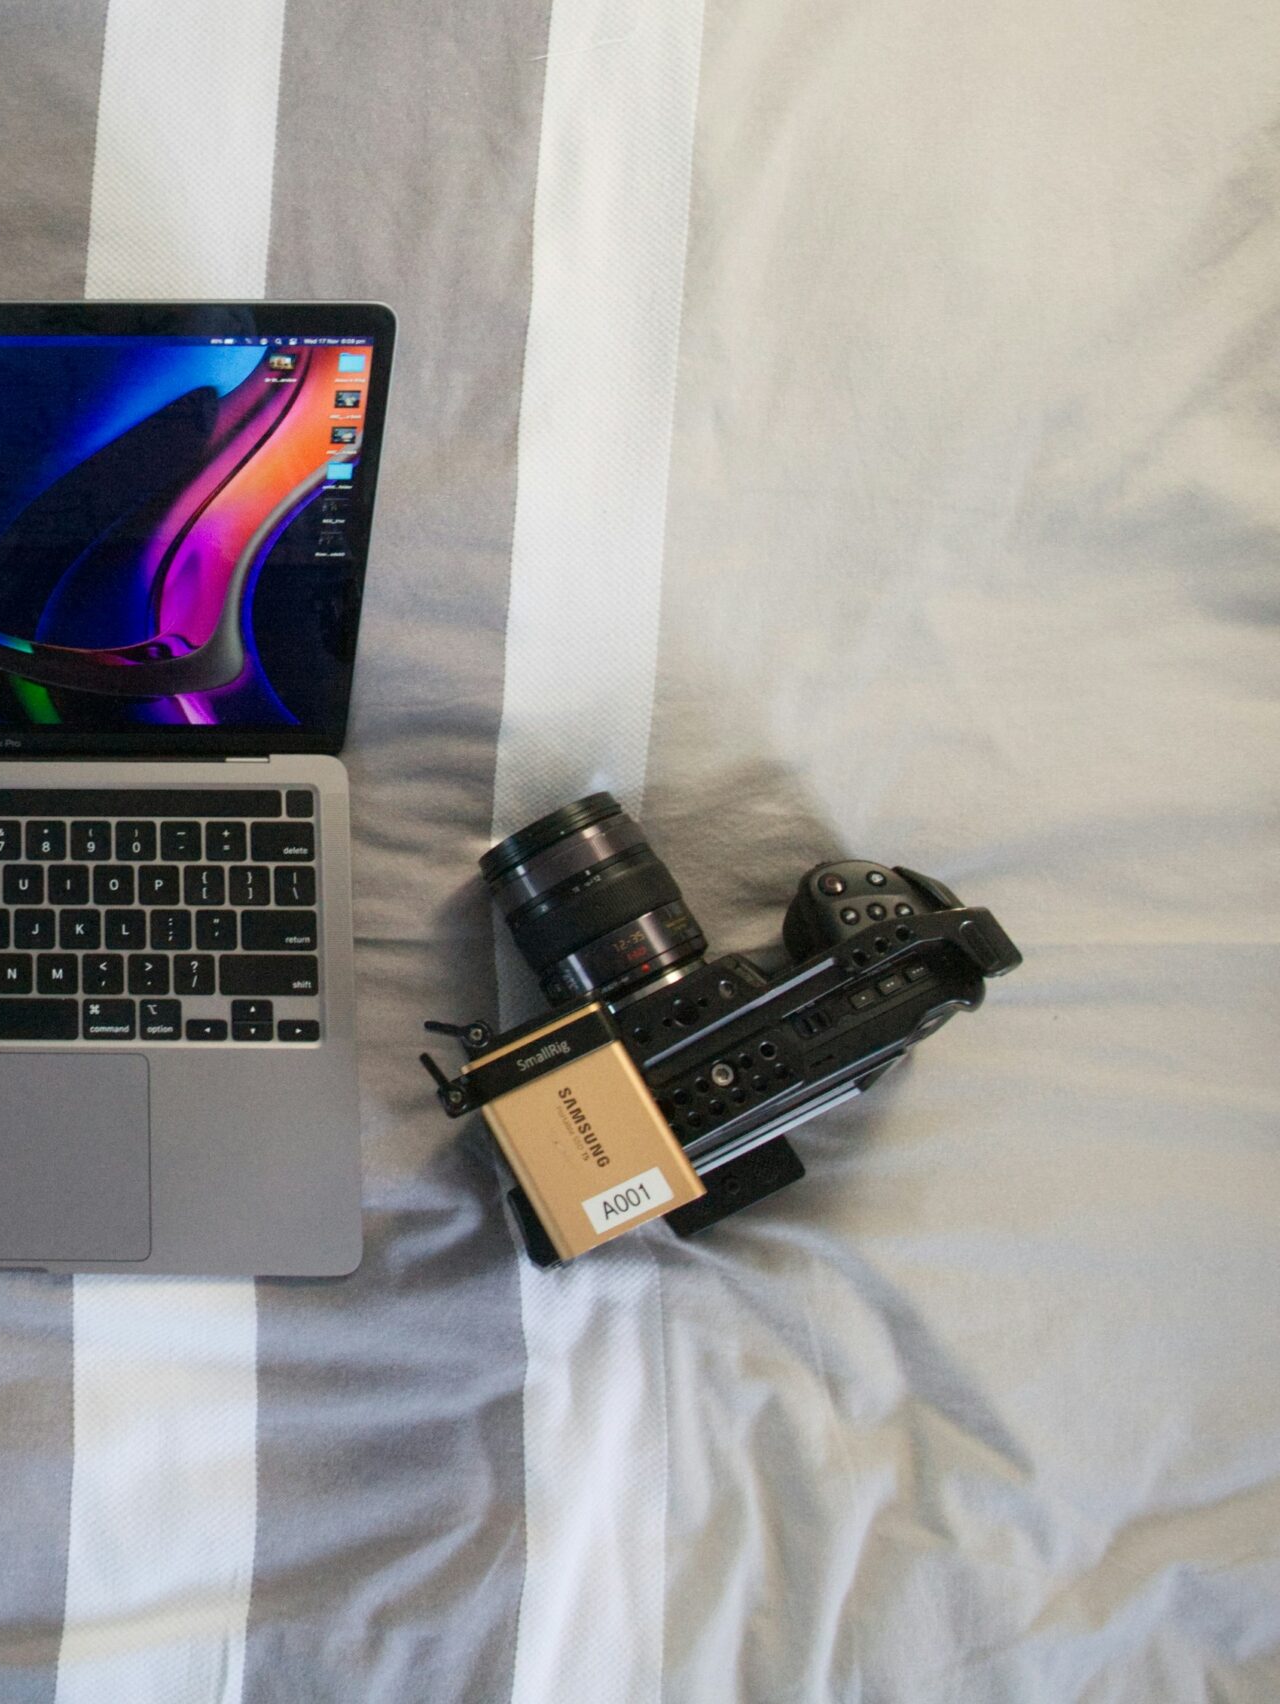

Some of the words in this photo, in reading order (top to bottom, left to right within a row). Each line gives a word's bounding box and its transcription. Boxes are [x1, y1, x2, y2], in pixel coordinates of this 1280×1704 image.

[5, 739, 21, 748] Pro
[41, 841, 51, 853] 8
[86, 841, 96, 853] 9
[131, 841, 141, 854] 0
[283, 846, 308, 855] delete
[18, 879, 29, 891] U
[66, 879, 71, 891] I
[108, 878, 119, 891] O
[154, 879, 164, 891] P
[31, 923, 39, 935] J
[75, 923, 85, 935] K
[121, 923, 130, 936] L
[285, 936, 311, 944] return
[190, 960, 199, 973] ?
[7, 967, 17, 980] N
[51, 968, 64, 980] M
[292, 979, 312, 989] shift
[89, 1024, 130, 1034] command
[146, 1024, 174, 1034] option
[516, 1040, 571, 1072] SmallRig
[558, 1087, 610, 1168] SAMSUNG
[603, 1183, 651, 1220] A001
